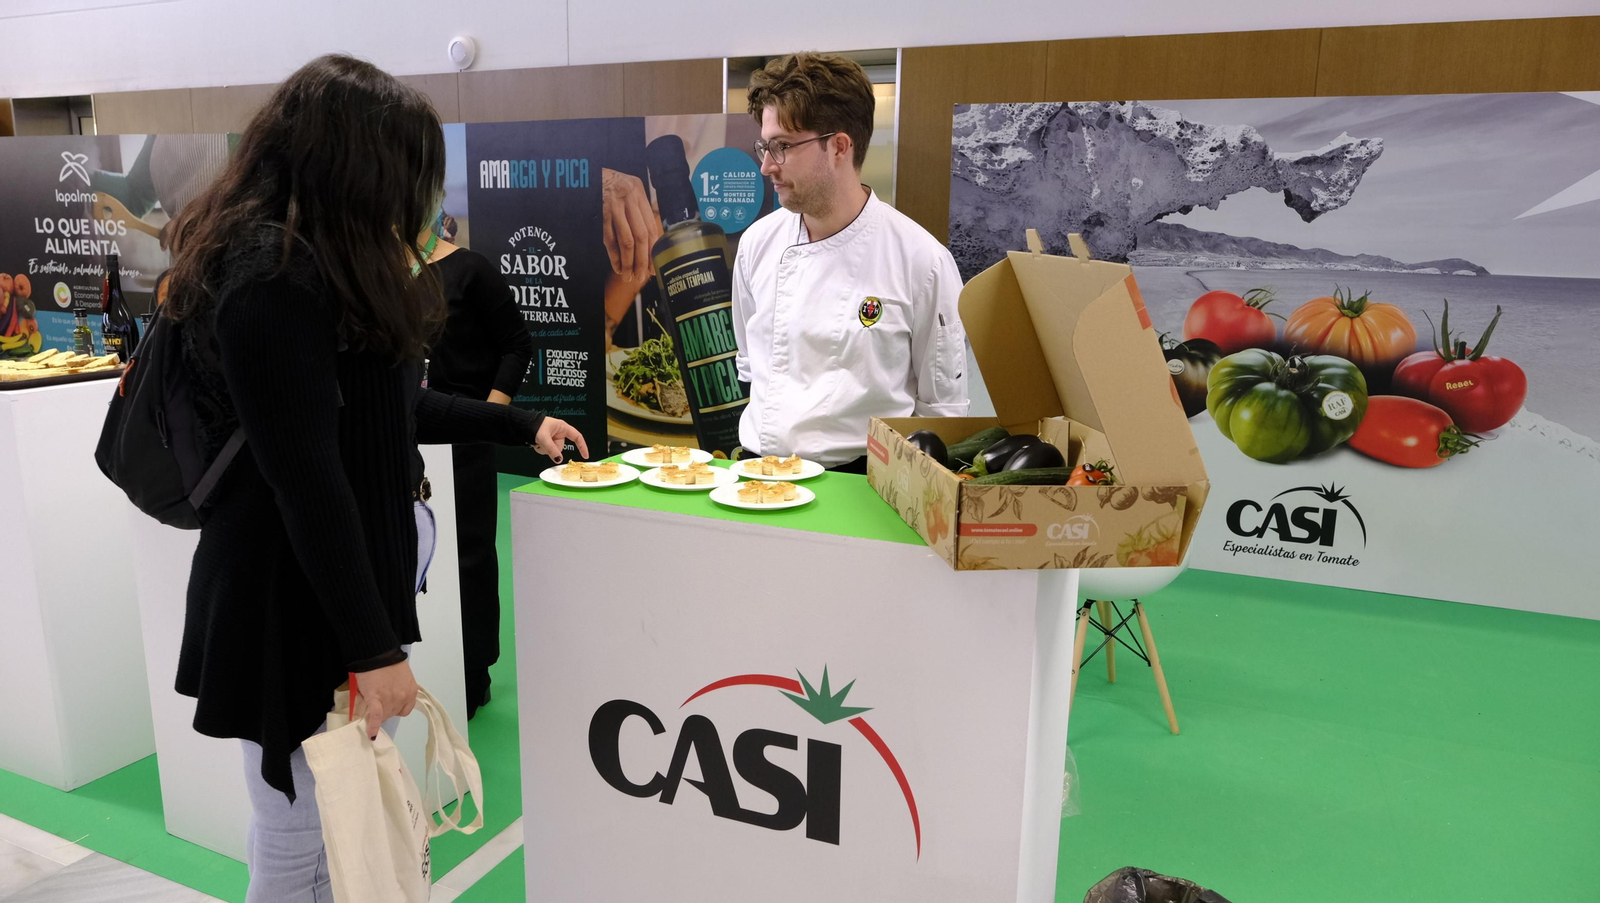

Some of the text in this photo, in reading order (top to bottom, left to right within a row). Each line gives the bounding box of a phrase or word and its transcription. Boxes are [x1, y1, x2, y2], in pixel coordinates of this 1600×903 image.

[480, 158, 589, 189] AMARGA Y PICA
[55, 189, 98, 207] lapalma
[34, 217, 127, 237] LO QUE NOS
[45, 238, 122, 256] ALIMENTA
[508, 225, 556, 252] POTENCIA
[500, 253, 570, 280] SABOR
[536, 277, 543, 285] LA
[686, 270, 715, 289] TEMPRANA
[520, 310, 577, 324] TERRANEA
[546, 349, 589, 361] EXQUISITAS
[547, 358, 582, 369] CARNES Y
[547, 367, 587, 379] DELICIOSOS
[547, 376, 585, 388] PESCADOS
[689, 359, 743, 407] Y PICA
[1046, 522, 1090, 540] CASI
[1226, 499, 1338, 547] CASI
[1223, 540, 1360, 567] Especialistas en Tomate
[588, 699, 842, 846] CASI
